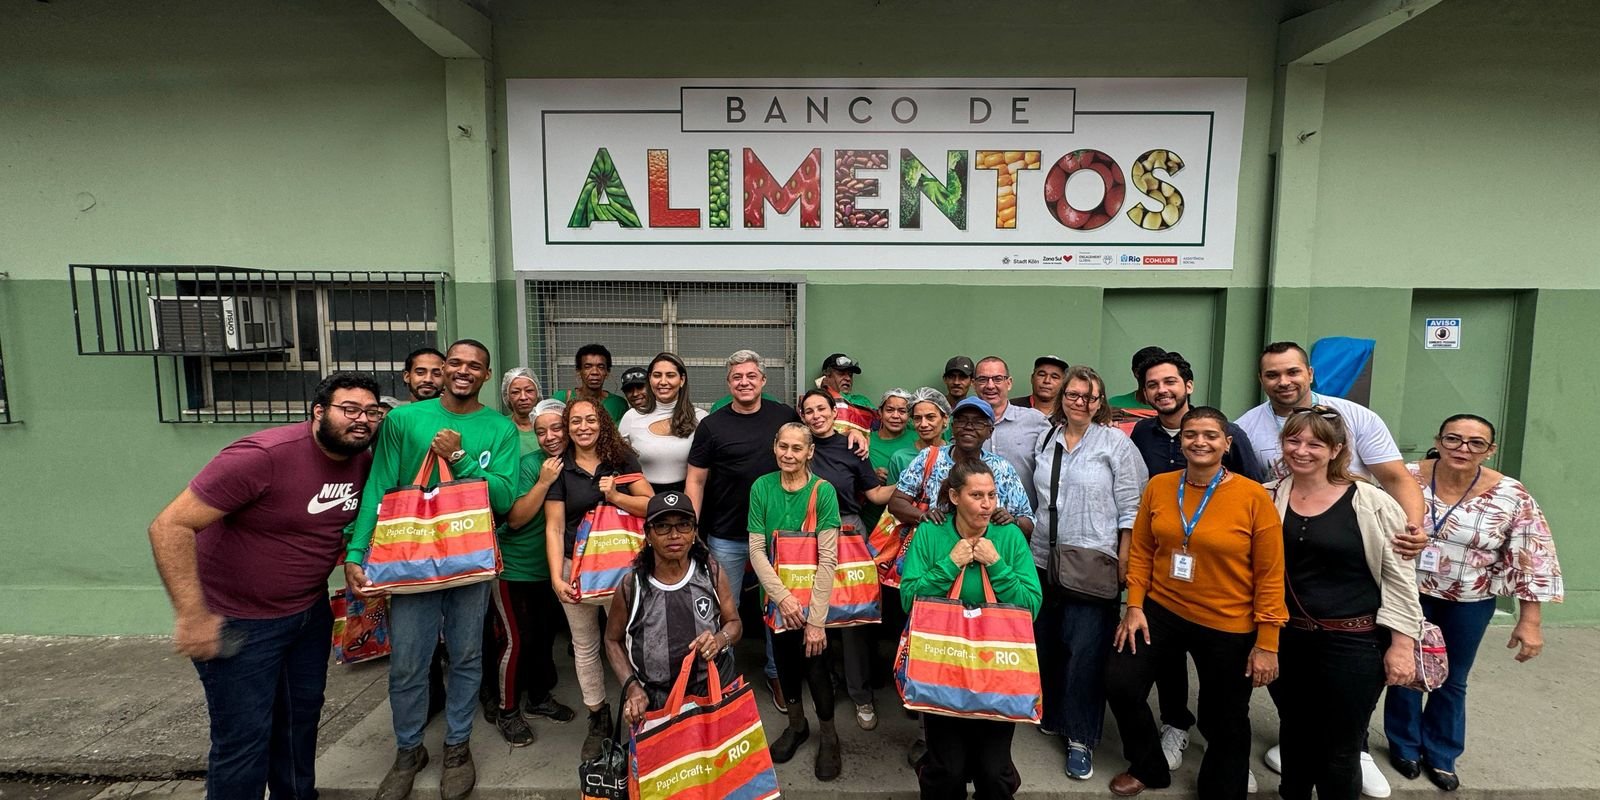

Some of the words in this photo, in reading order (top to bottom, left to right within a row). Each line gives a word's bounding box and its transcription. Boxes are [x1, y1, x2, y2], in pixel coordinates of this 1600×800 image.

[726, 96, 918, 124] BANCO
[970, 97, 1029, 124] DE
[567, 147, 1185, 231] ALIMENTOS
[226, 310, 235, 335] Consul
[319, 483, 354, 498] NIKE
[342, 498, 358, 511] SB
[386, 527, 405, 537] Papel
[406, 526, 428, 536] Craft
[450, 518, 474, 532] RIO
[593, 540, 612, 548] Papel
[792, 574, 810, 583] Papel
[848, 570, 865, 581] RIO
[924, 644, 946, 655] Papel
[947, 647, 968, 659] Craft
[995, 651, 1020, 666] RIO
[656, 772, 679, 791] Papel
[680, 765, 704, 780] Craft
[728, 740, 750, 763] RIO
